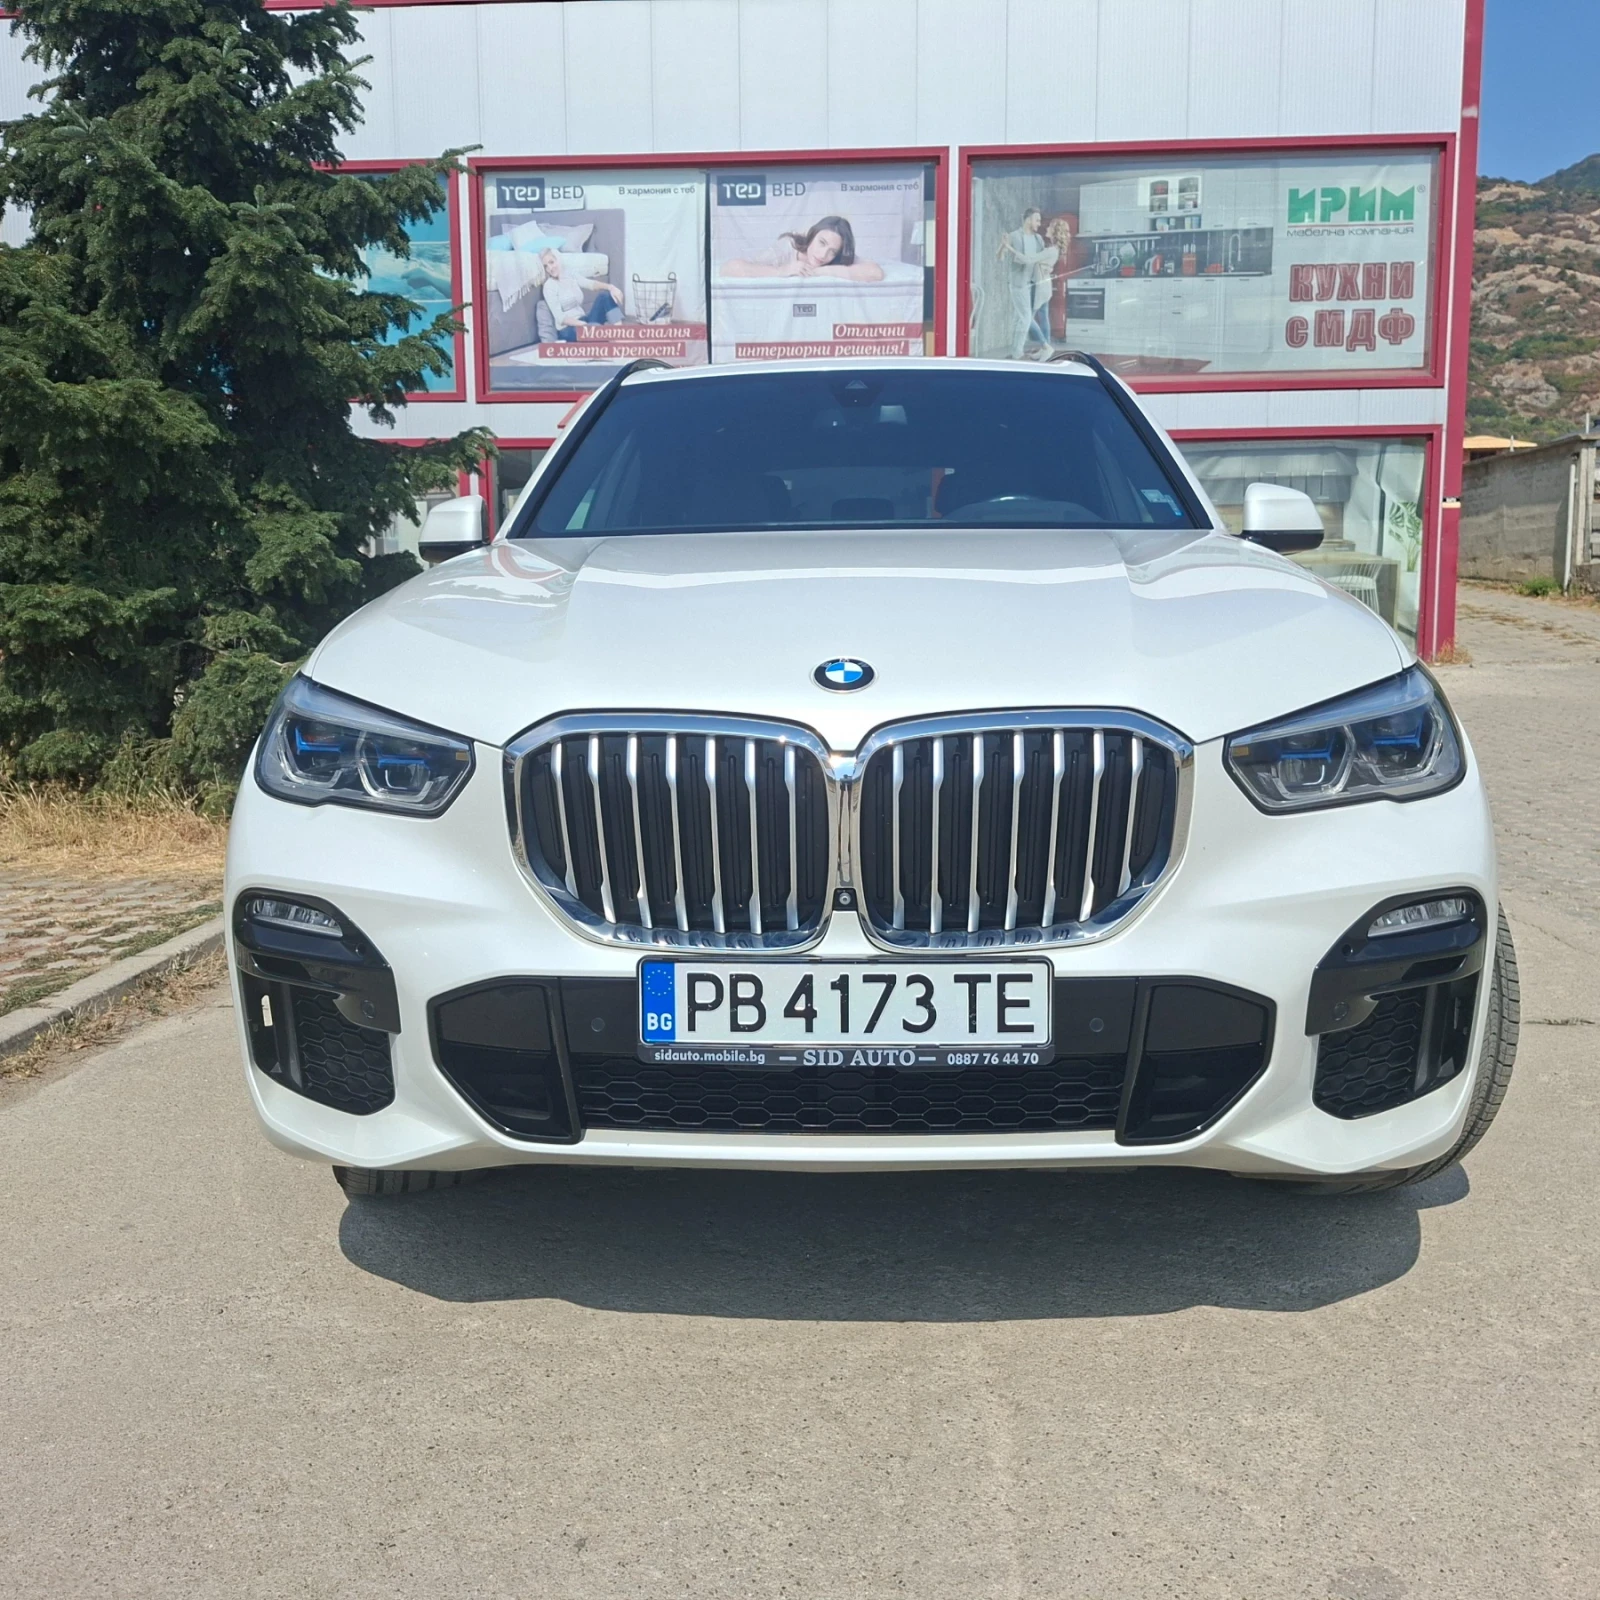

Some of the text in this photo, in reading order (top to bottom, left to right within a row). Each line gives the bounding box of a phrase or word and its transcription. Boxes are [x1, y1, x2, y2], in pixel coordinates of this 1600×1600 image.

[551, 185, 584, 200] BED
[618, 187, 625, 195] В
[627, 187, 671, 197] хармония
[680, 186, 695, 194] теб
[772, 182, 806, 197] BED
[841, 183, 847, 191] В
[850, 183, 895, 194] хармония
[903, 182, 919, 191] теб
[1287, 185, 1415, 223] ИРИМ
[1289, 261, 1415, 302] КУХНИ
[581, 326, 691, 339] Моята спалня
[835, 323, 906, 337] Отлични
[1313, 308, 1415, 352] МДФ
[546, 342, 682, 359] е моята крепост!
[737, 341, 905, 359] интериорни решения!
[687, 972, 1035, 1033] PB 4173 TE
[647, 1013, 672, 1031] BG
[654, 1049, 766, 1064] sidauto.mobile.bg
[803, 1050, 916, 1066] SID AUTO
[947, 1053, 1039, 1065] 0887 76 44 70
